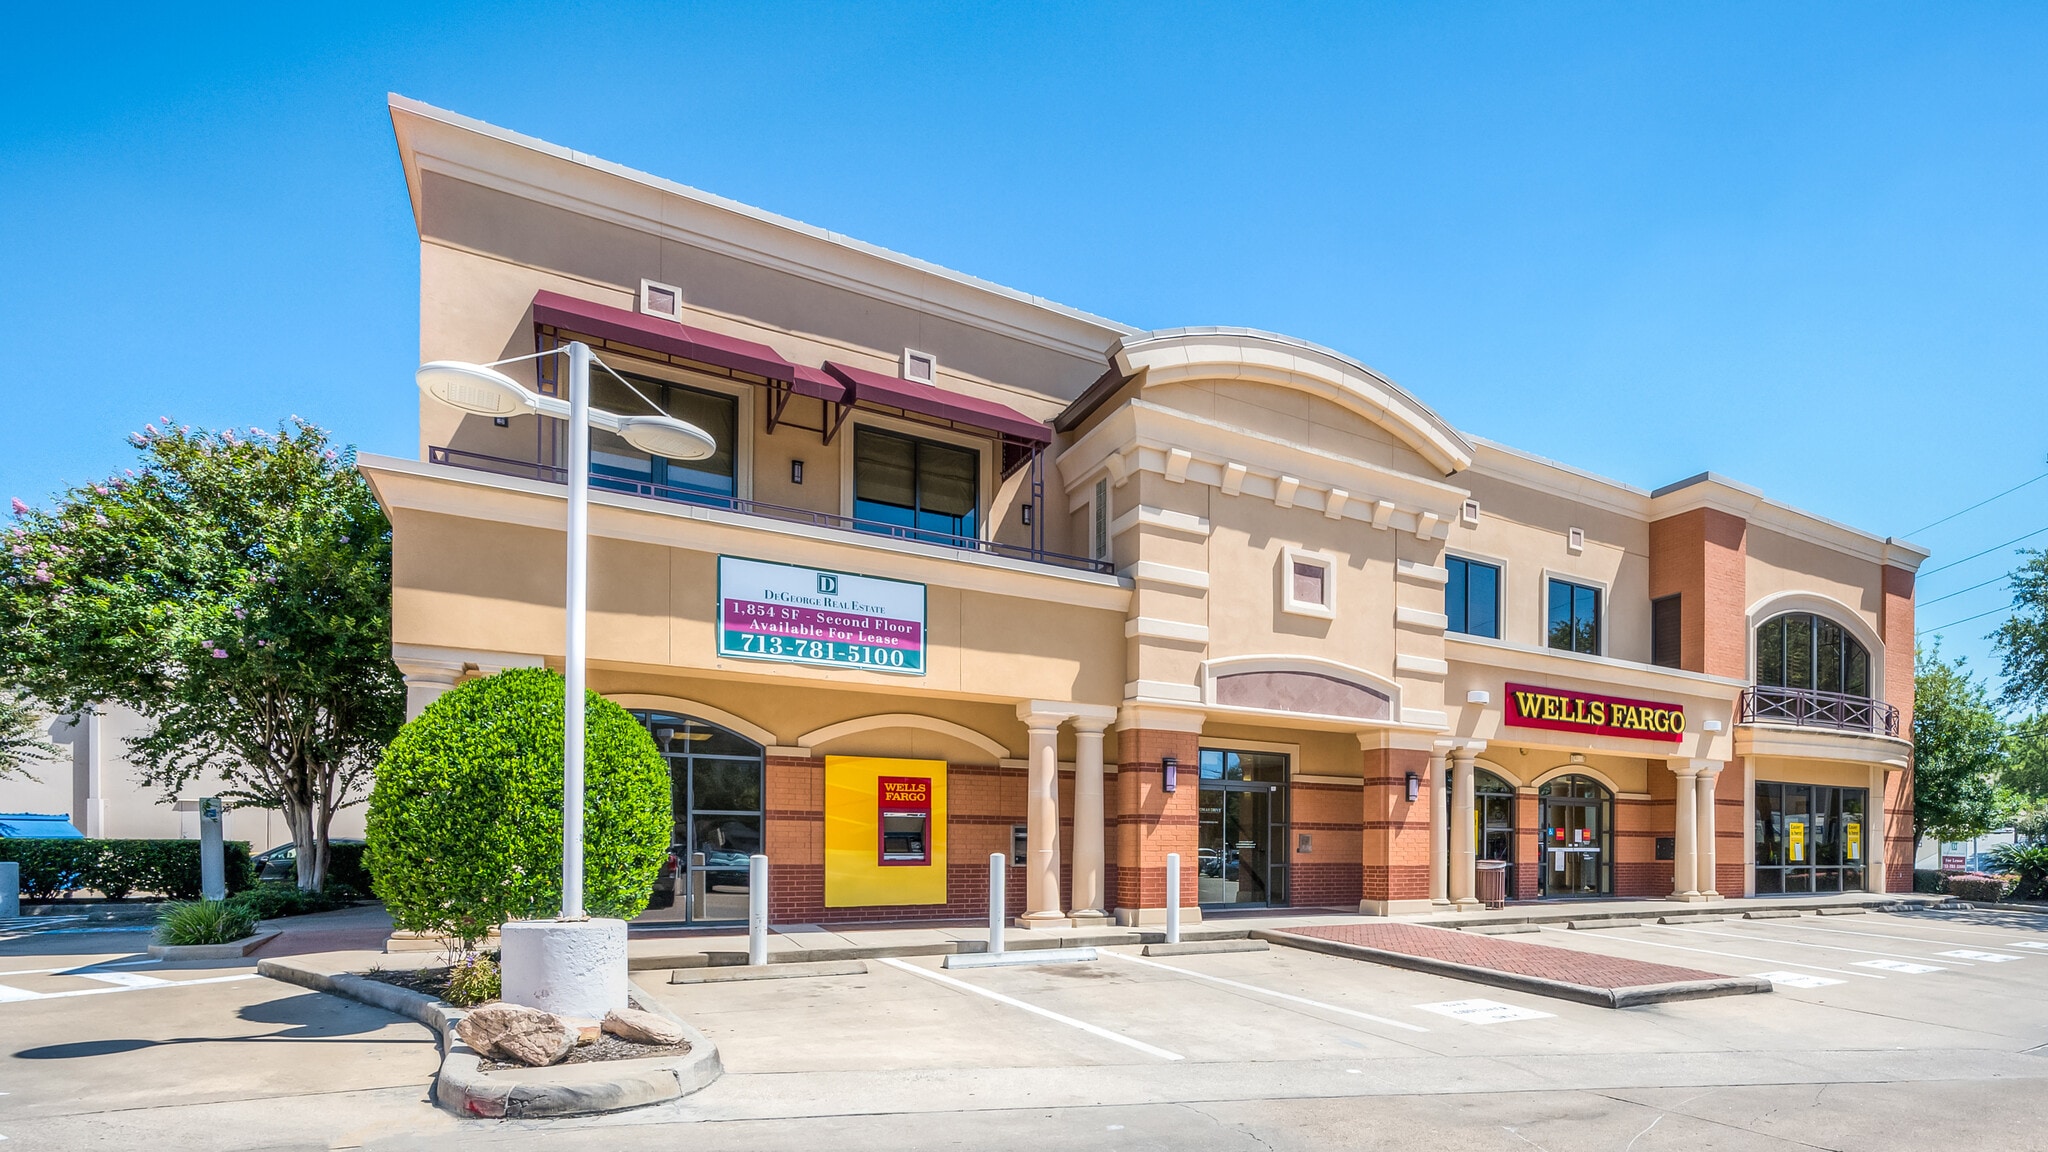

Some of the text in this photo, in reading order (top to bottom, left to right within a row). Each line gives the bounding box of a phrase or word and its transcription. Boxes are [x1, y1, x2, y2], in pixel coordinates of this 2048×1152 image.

[821, 577, 835, 592] D
[732, 602, 775, 617] 1,854
[782, 609, 800, 620] SF
[816, 613, 869, 629] Second
[875, 620, 913, 634] Floor
[750, 619, 899, 645] Available For Lease
[741, 634, 904, 667] 713-781-5100
[1514, 691, 1686, 734] WELLS FARGO
[884, 783, 926, 792] WELLS
[885, 792, 926, 801] FARGO
